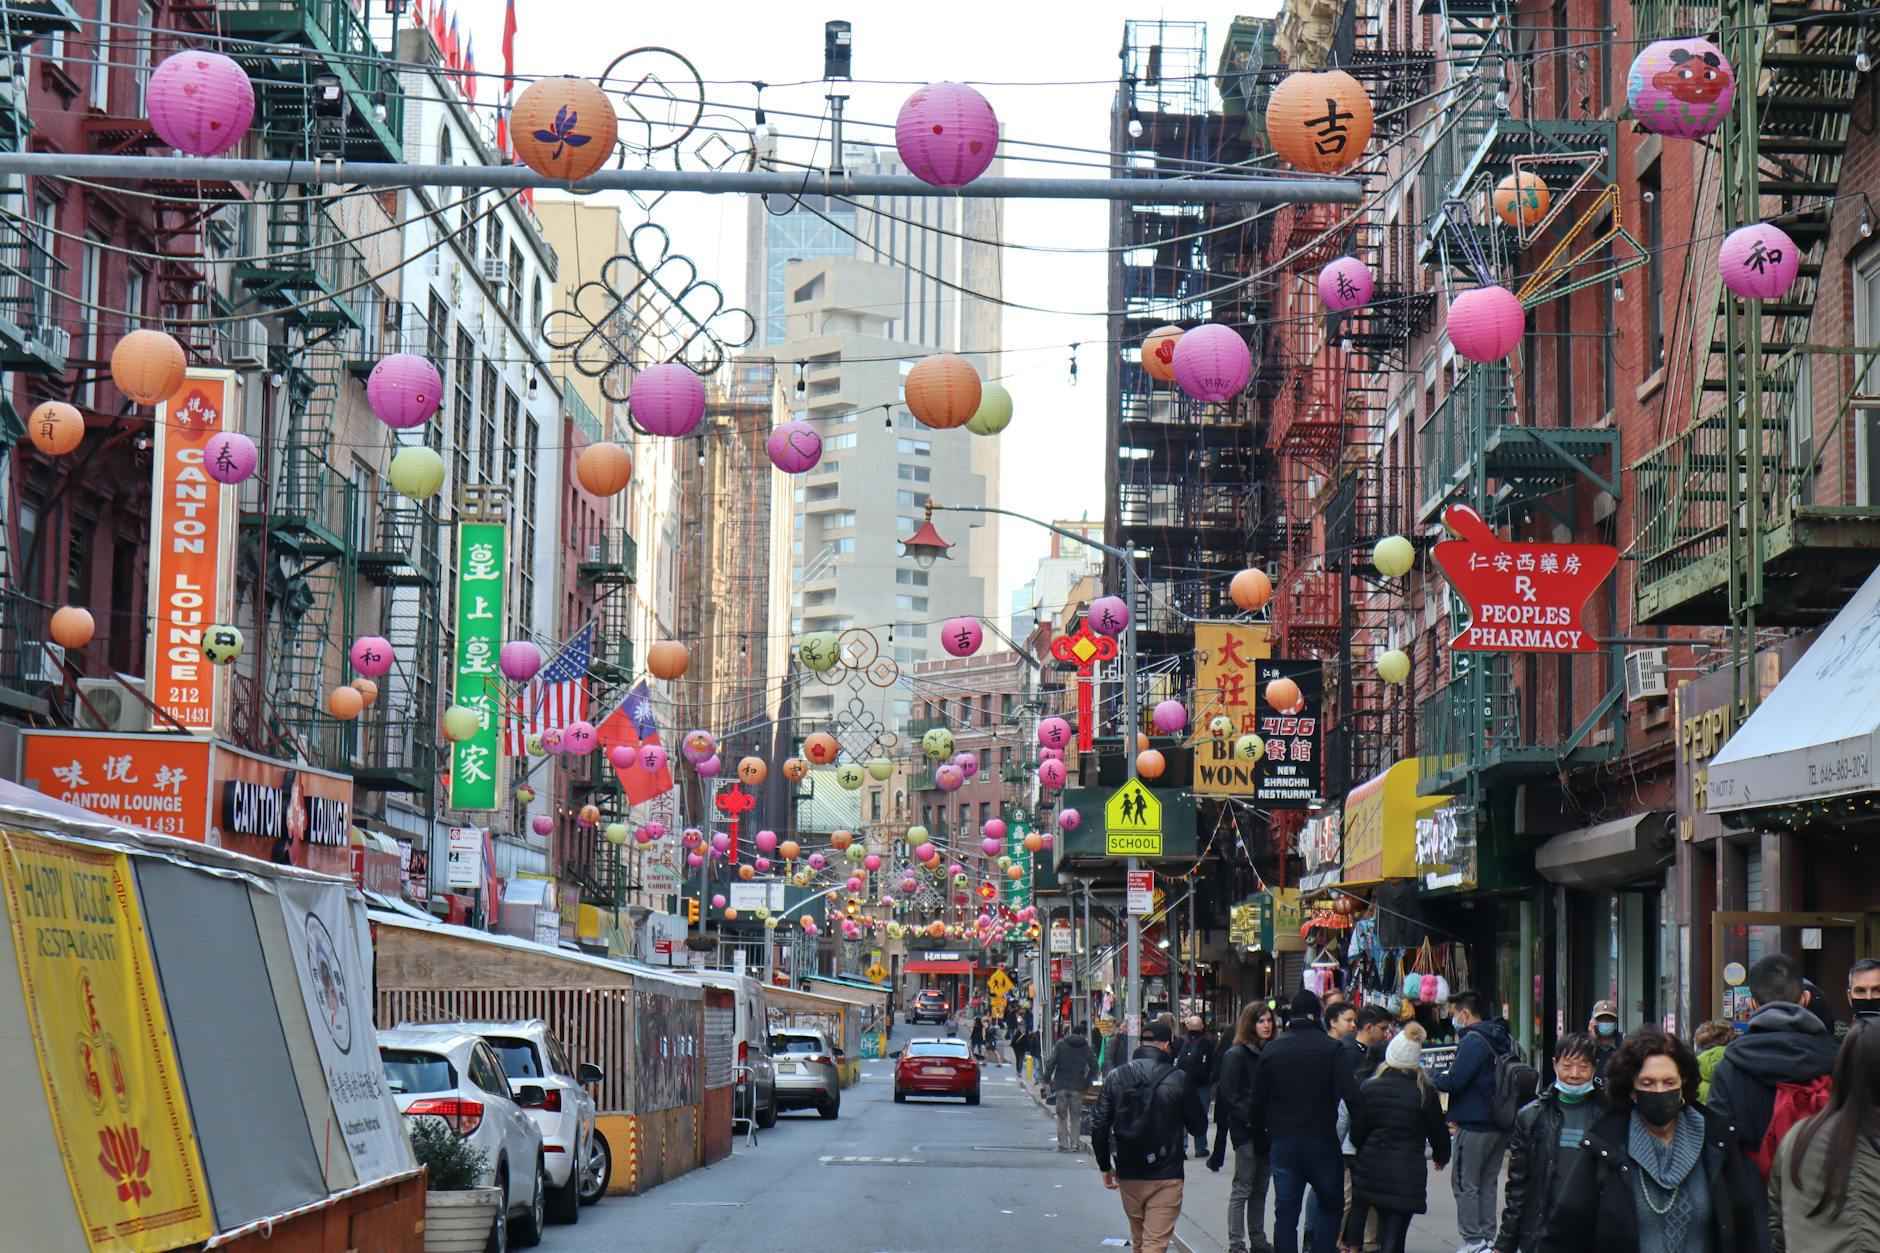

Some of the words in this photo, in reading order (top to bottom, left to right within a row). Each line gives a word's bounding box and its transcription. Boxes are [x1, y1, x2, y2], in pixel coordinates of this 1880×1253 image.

[1304, 98, 1354, 155] 吉
[1743, 239, 1783, 275] 和
[1335, 270, 1361, 302] 春
[216, 441, 239, 474] 春
[172, 447, 207, 554] CANTON
[1468, 551, 1583, 576] 仁安西藥房
[1101, 608, 1121, 629] 春
[1480, 604, 1571, 625] PEOPLES
[168, 573, 204, 681] LOUNGE
[954, 626, 972, 649] 吉
[1469, 627, 1582, 649] PHARMACY
[359, 648, 381, 667] 和
[1215, 631, 1249, 706] 大旺
[169, 687, 200, 703] 212
[1262, 717, 1315, 736] 456
[1212, 740, 1236, 760] BI
[1243, 742, 1257, 758] 吉
[1277, 765, 1297, 776] NEW
[1263, 777, 1310, 788] SHANGHAI
[61, 791, 120, 809] CANTON
[124, 794, 183, 812] LOUNGE
[1258, 789, 1318, 800] RESTAURANT
[233, 780, 283, 837] CANTON
[310, 795, 350, 847] LOUNGE
[1111, 838, 1158, 849] SCHOOL
